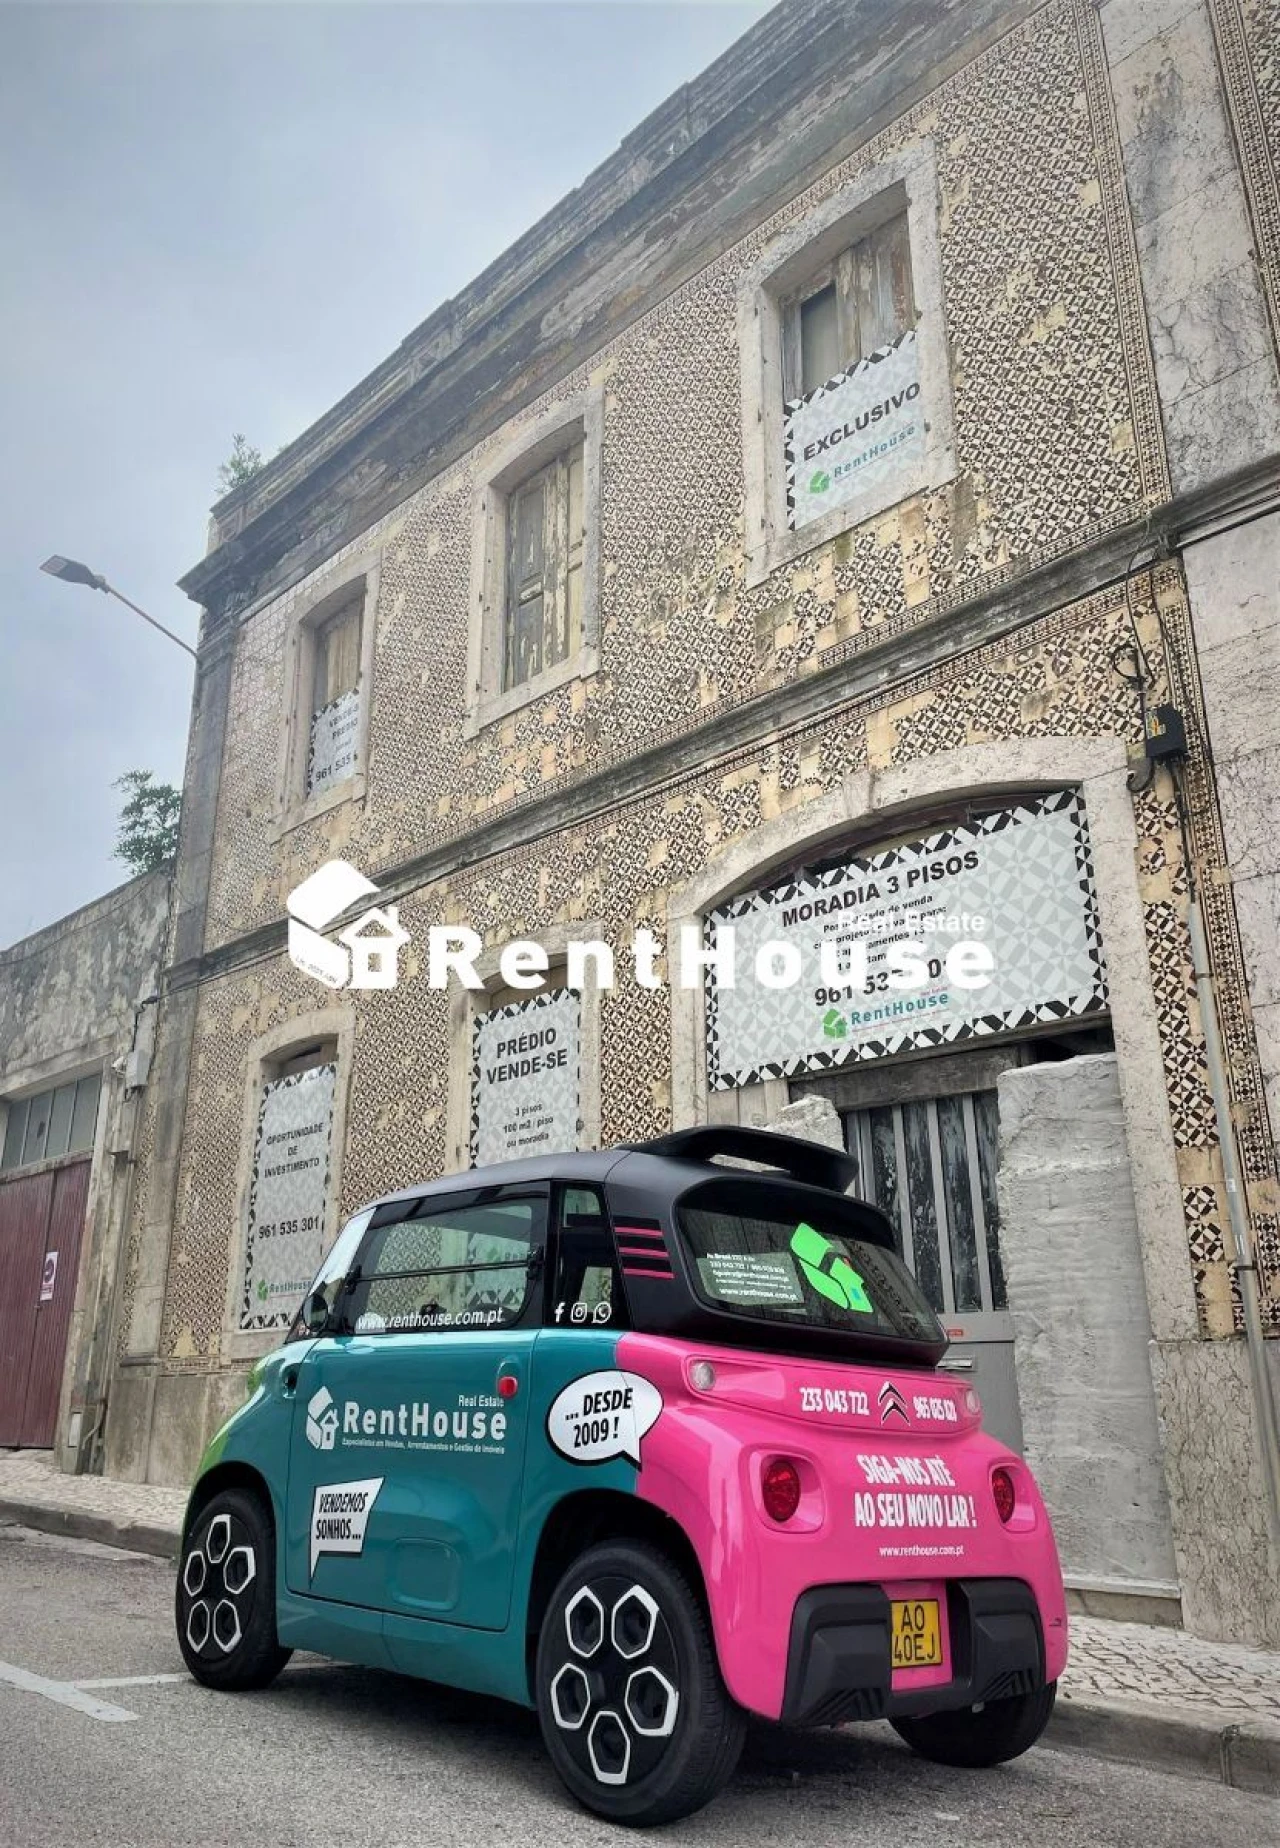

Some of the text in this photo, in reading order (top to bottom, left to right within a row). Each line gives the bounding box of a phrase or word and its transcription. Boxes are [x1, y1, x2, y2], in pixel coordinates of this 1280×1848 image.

[803, 382, 920, 461] EXCLUSIVO
[834, 425, 916, 478] RentHouse
[782, 883, 880, 928] MORADIA
[887, 876, 899, 894] 3
[907, 850, 979, 888] PISOS
[902, 895, 933, 910] venda
[815, 985, 853, 1007] 961
[851, 993, 948, 1025] RentHouse
[496, 1027, 557, 1059] PRÉDIO
[486, 1048, 568, 1085] VENDE-SE
[521, 1103, 543, 1117] pisos
[266, 1122, 324, 1146] OPORTUNIDADE
[537, 1116, 554, 1129] piso
[287, 1145, 299, 1157] DE
[518, 1132, 549, 1146] moradia
[264, 1157, 320, 1179] INVESTIMENTO
[258, 1215, 320, 1239] 961 535 301
[357, 1307, 503, 1330] www.renthouse.com.pt
[458, 1394, 505, 1408] Real Estate
[583, 1387, 633, 1417] DESDE
[799, 1386, 823, 1412] 233
[824, 1388, 848, 1413] 043
[343, 1401, 507, 1441] RentHouse
[856, 1454, 931, 1486] SIGA-NOS
[319, 1491, 369, 1513] VENDEMOS
[854, 1492, 876, 1527] AO
[877, 1493, 904, 1527] SEU
[905, 1493, 944, 1527] NOVO
[943, 1494, 970, 1527] LAR
[879, 1544, 965, 1557] www.renthouse.com.pt
[895, 1632, 936, 1662] 40EJ
